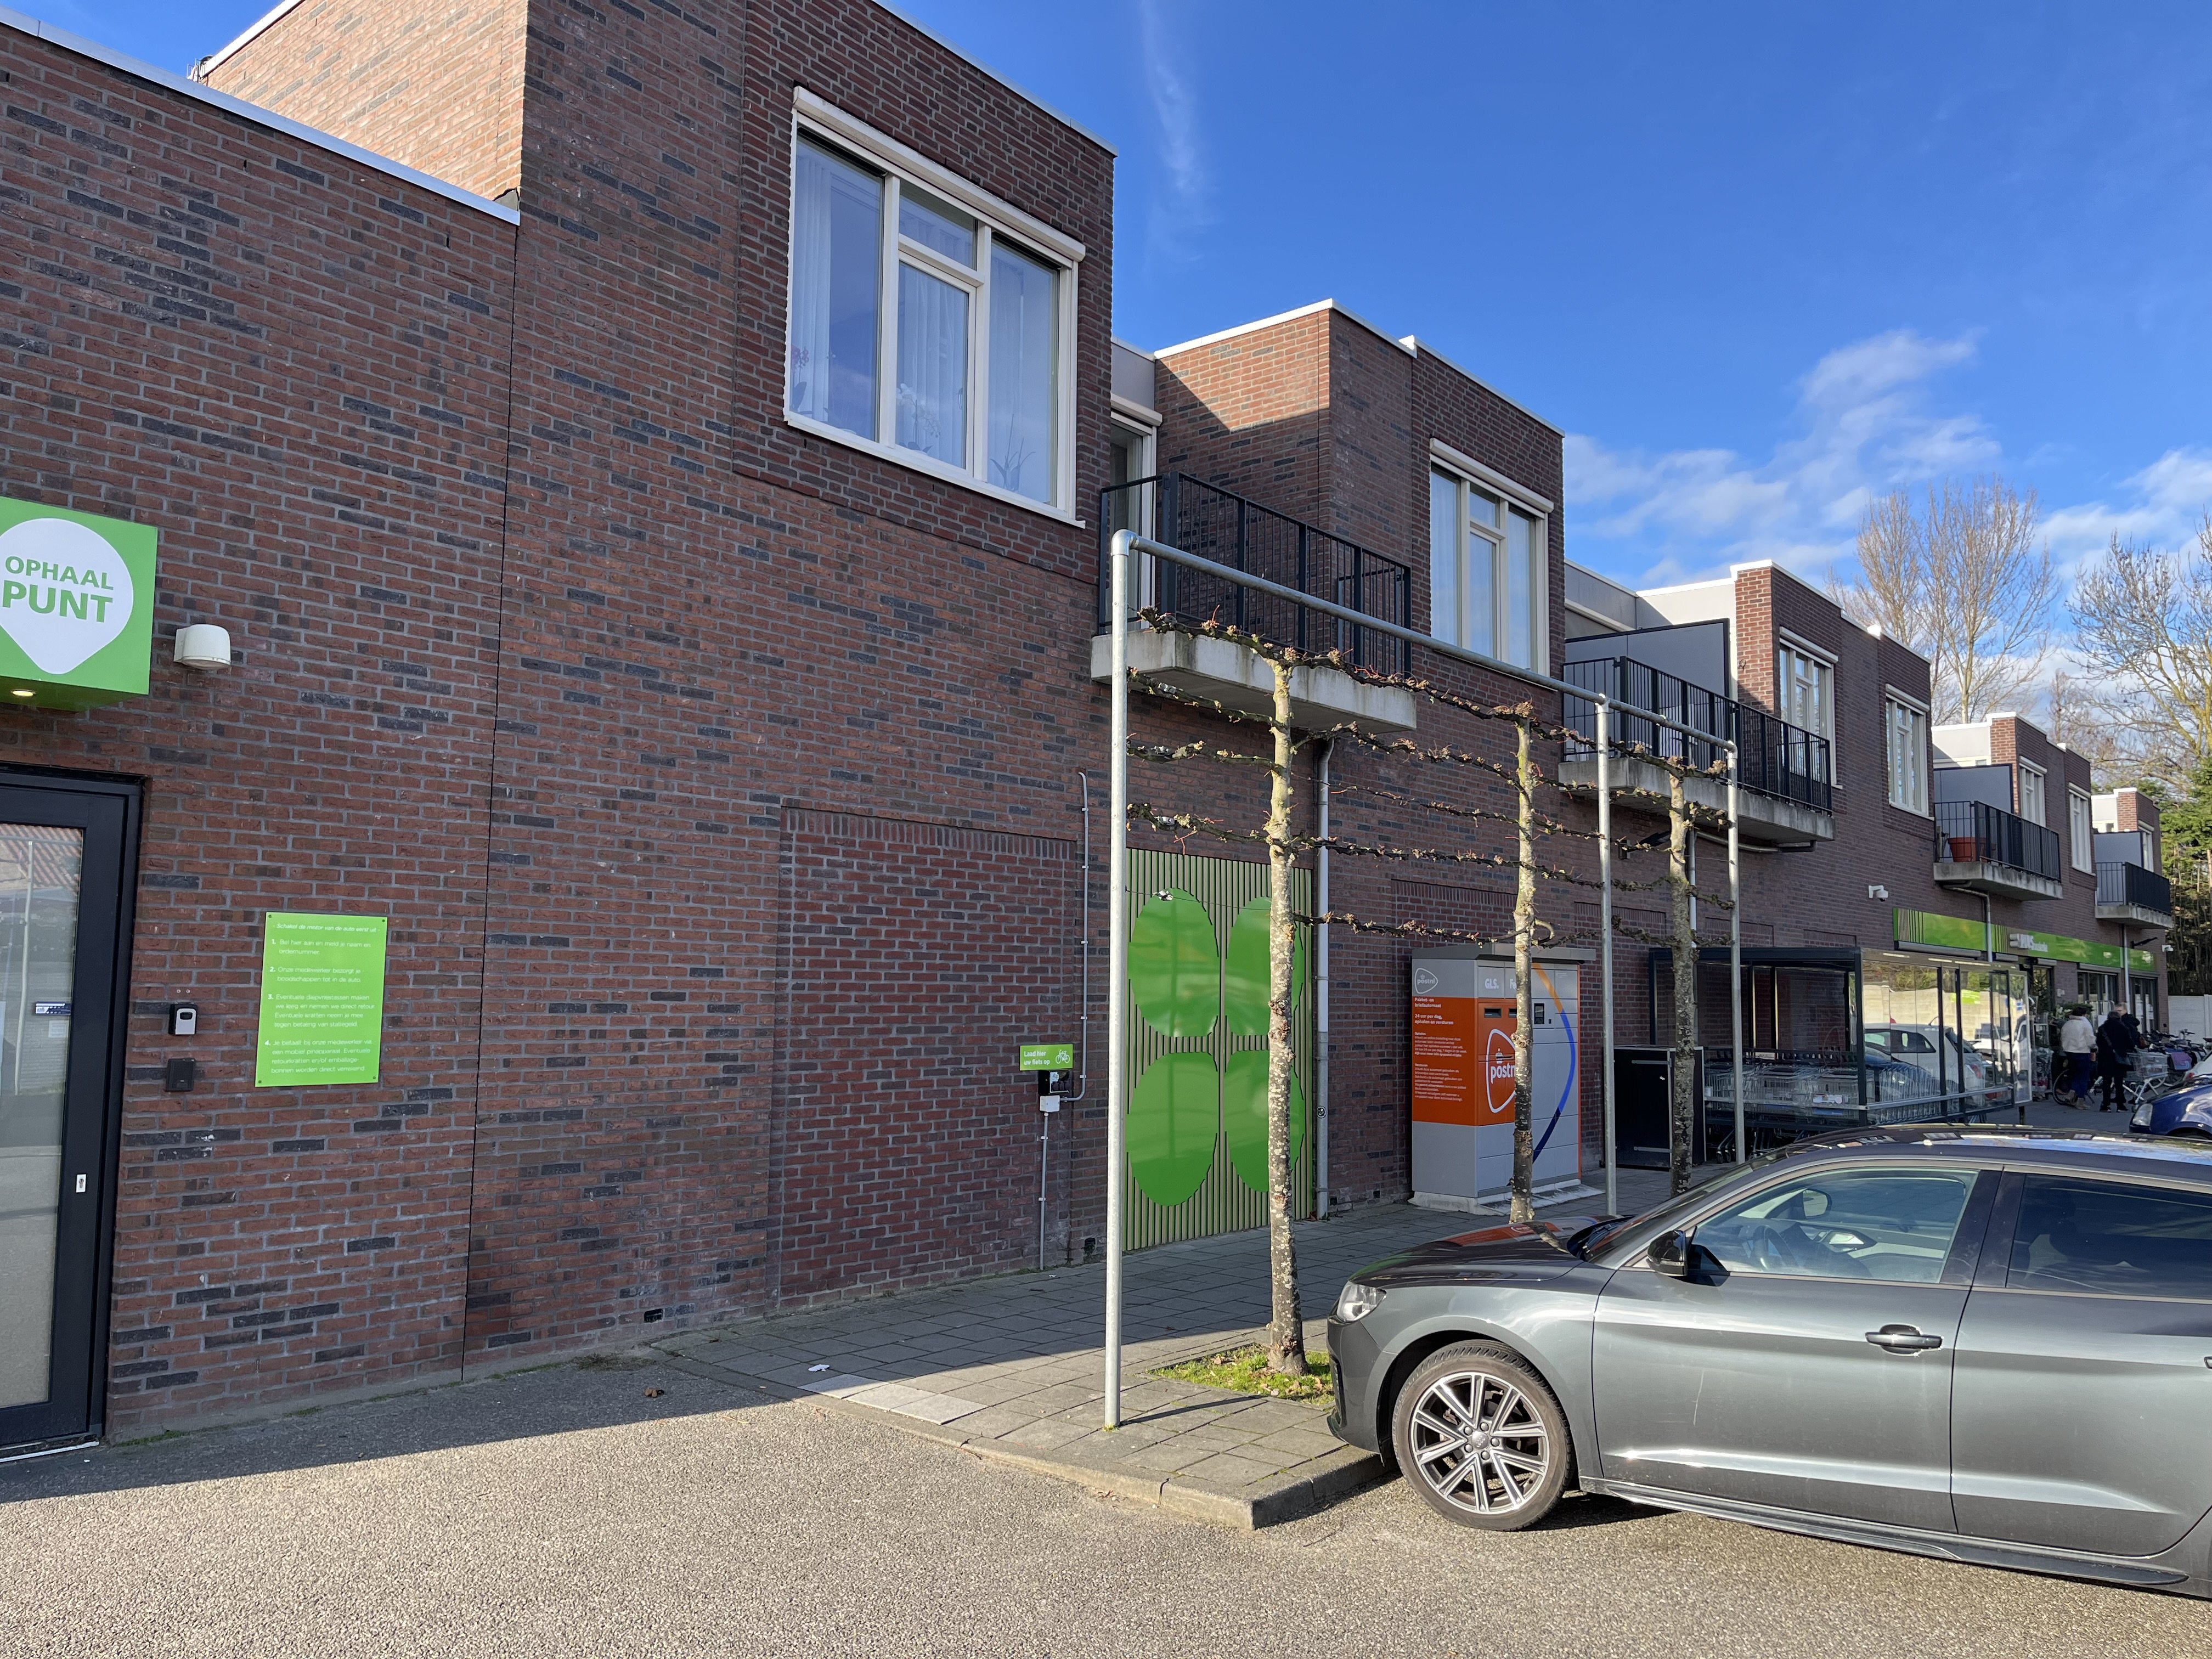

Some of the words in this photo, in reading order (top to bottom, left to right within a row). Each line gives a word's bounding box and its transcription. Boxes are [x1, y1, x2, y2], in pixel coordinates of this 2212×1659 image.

[5, 556, 114, 590] OPHAAL
[2, 579, 113, 623] PUNT
[1491, 1062, 1516, 1085] postn
